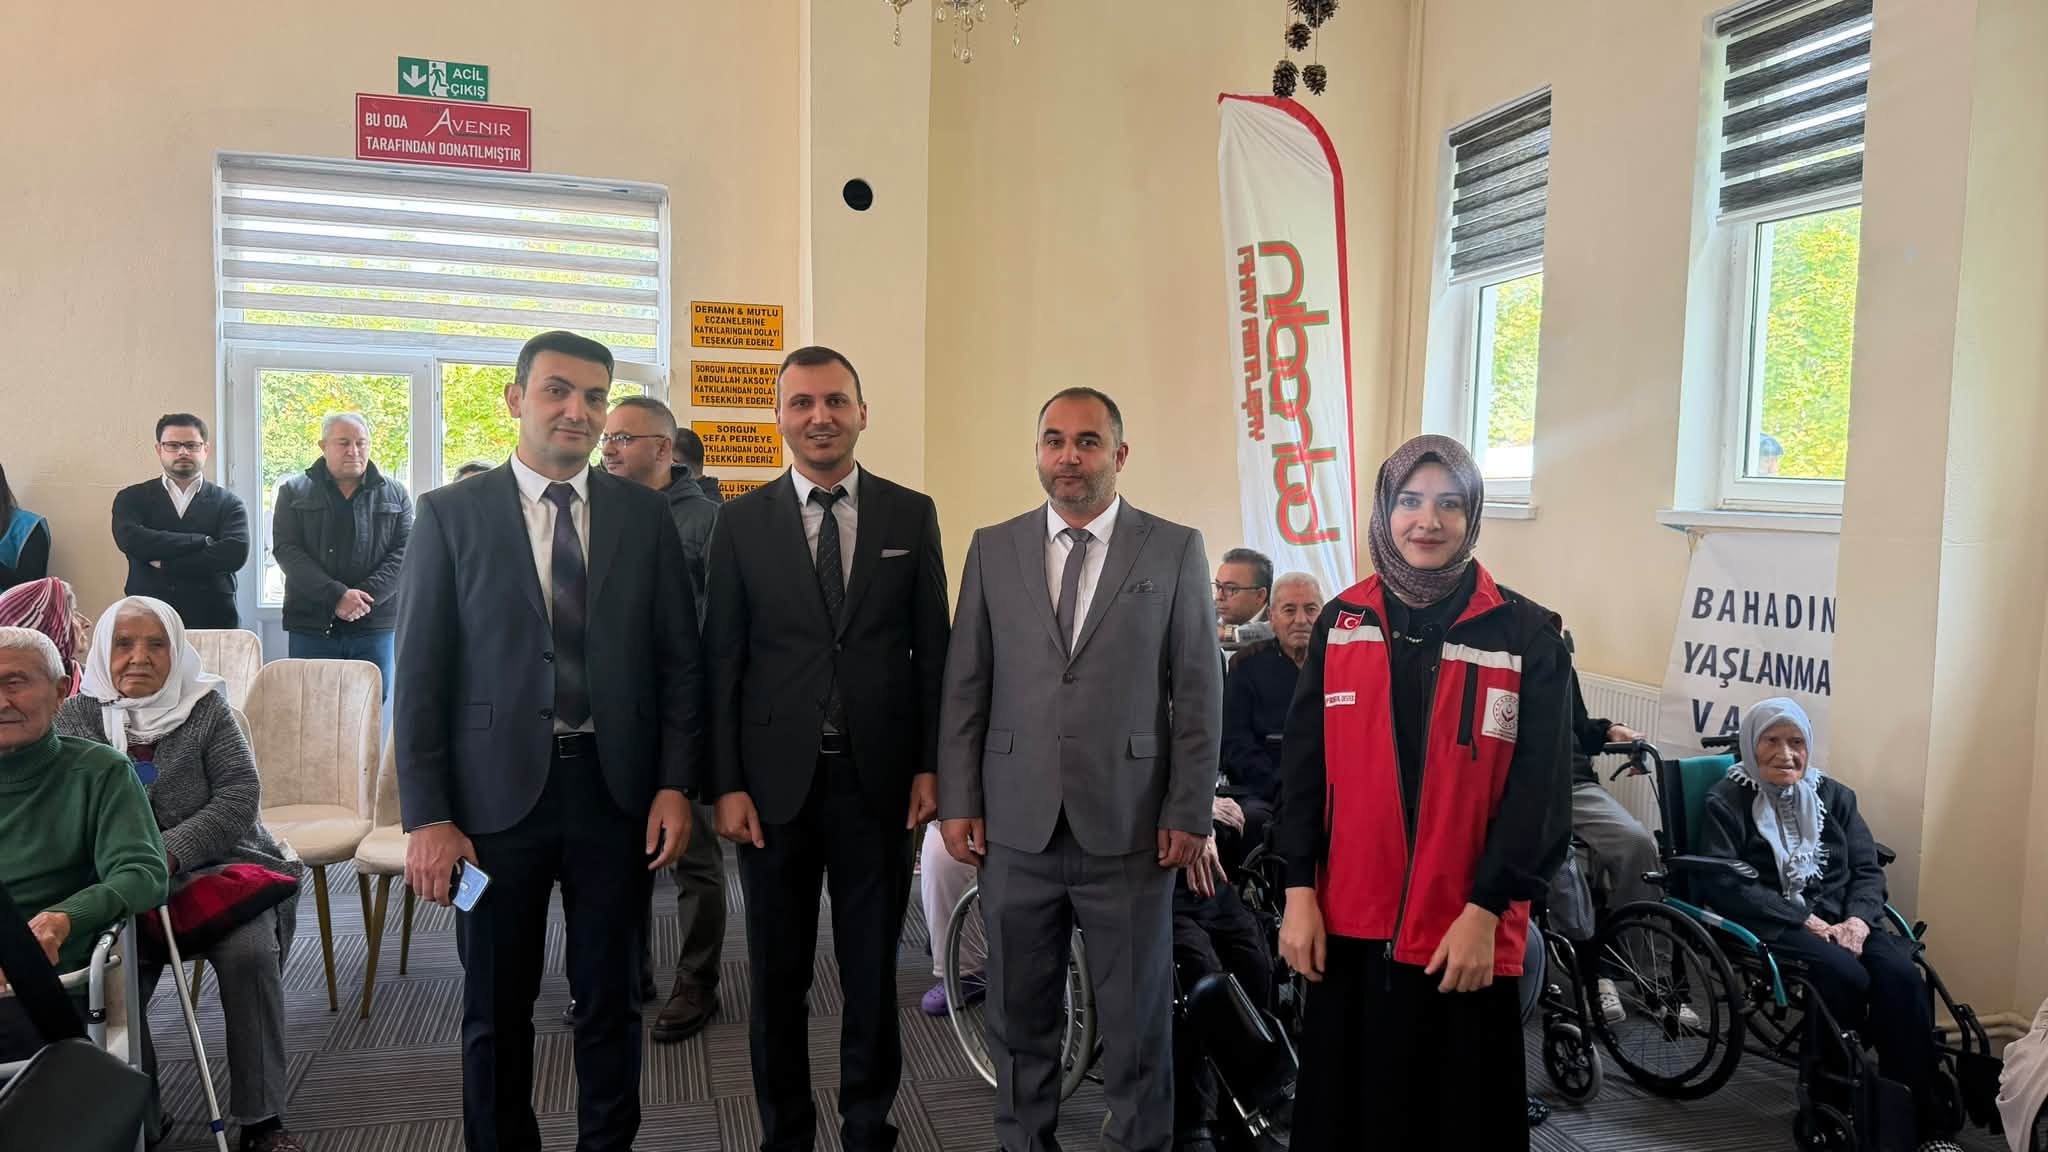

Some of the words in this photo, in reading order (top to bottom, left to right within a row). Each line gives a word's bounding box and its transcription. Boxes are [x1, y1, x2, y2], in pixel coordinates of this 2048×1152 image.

[452, 66, 484, 81] ACİL
[450, 83, 486, 99] ÇIKIŞ
[365, 112, 380, 127] BU
[384, 114, 408, 129] ODA
[425, 108, 512, 137] AVENIR
[365, 136, 435, 155] TARAFINDAN
[439, 143, 521, 163] DONATILMIŞTIR
[695, 305, 735, 315] DERMAN
[737, 307, 744, 315] &
[747, 308, 778, 317] MUTLU
[694, 325, 752, 336] KATKILARINDAN
[754, 328, 780, 337] DOLAYI
[700, 336, 744, 346] TEŞEKKÜR
[746, 338, 774, 347] EDERİZ
[695, 365, 726, 374] SORGUN
[697, 375, 740, 384] ABDULLAH
[694, 385, 752, 394] KATKILARINDAN
[754, 387, 776, 395] DOLAY
[700, 395, 744, 405] TEŞEKKÜR
[746, 396, 774, 406] EDERİZ
[717, 425, 757, 434] SORGUN
[703, 434, 726, 443] SEFA
[729, 435, 773, 444] PERDEYE
[704, 445, 752, 454] TKILARINDAN
[754, 446, 779, 455] DOLAYI
[704, 454, 744, 464] EŞEKKÜR
[746, 455, 774, 464] EDERİZ
[1691, 587, 1837, 634] BAHADIN
[1683, 640, 1832, 697] YAŞLANMA
